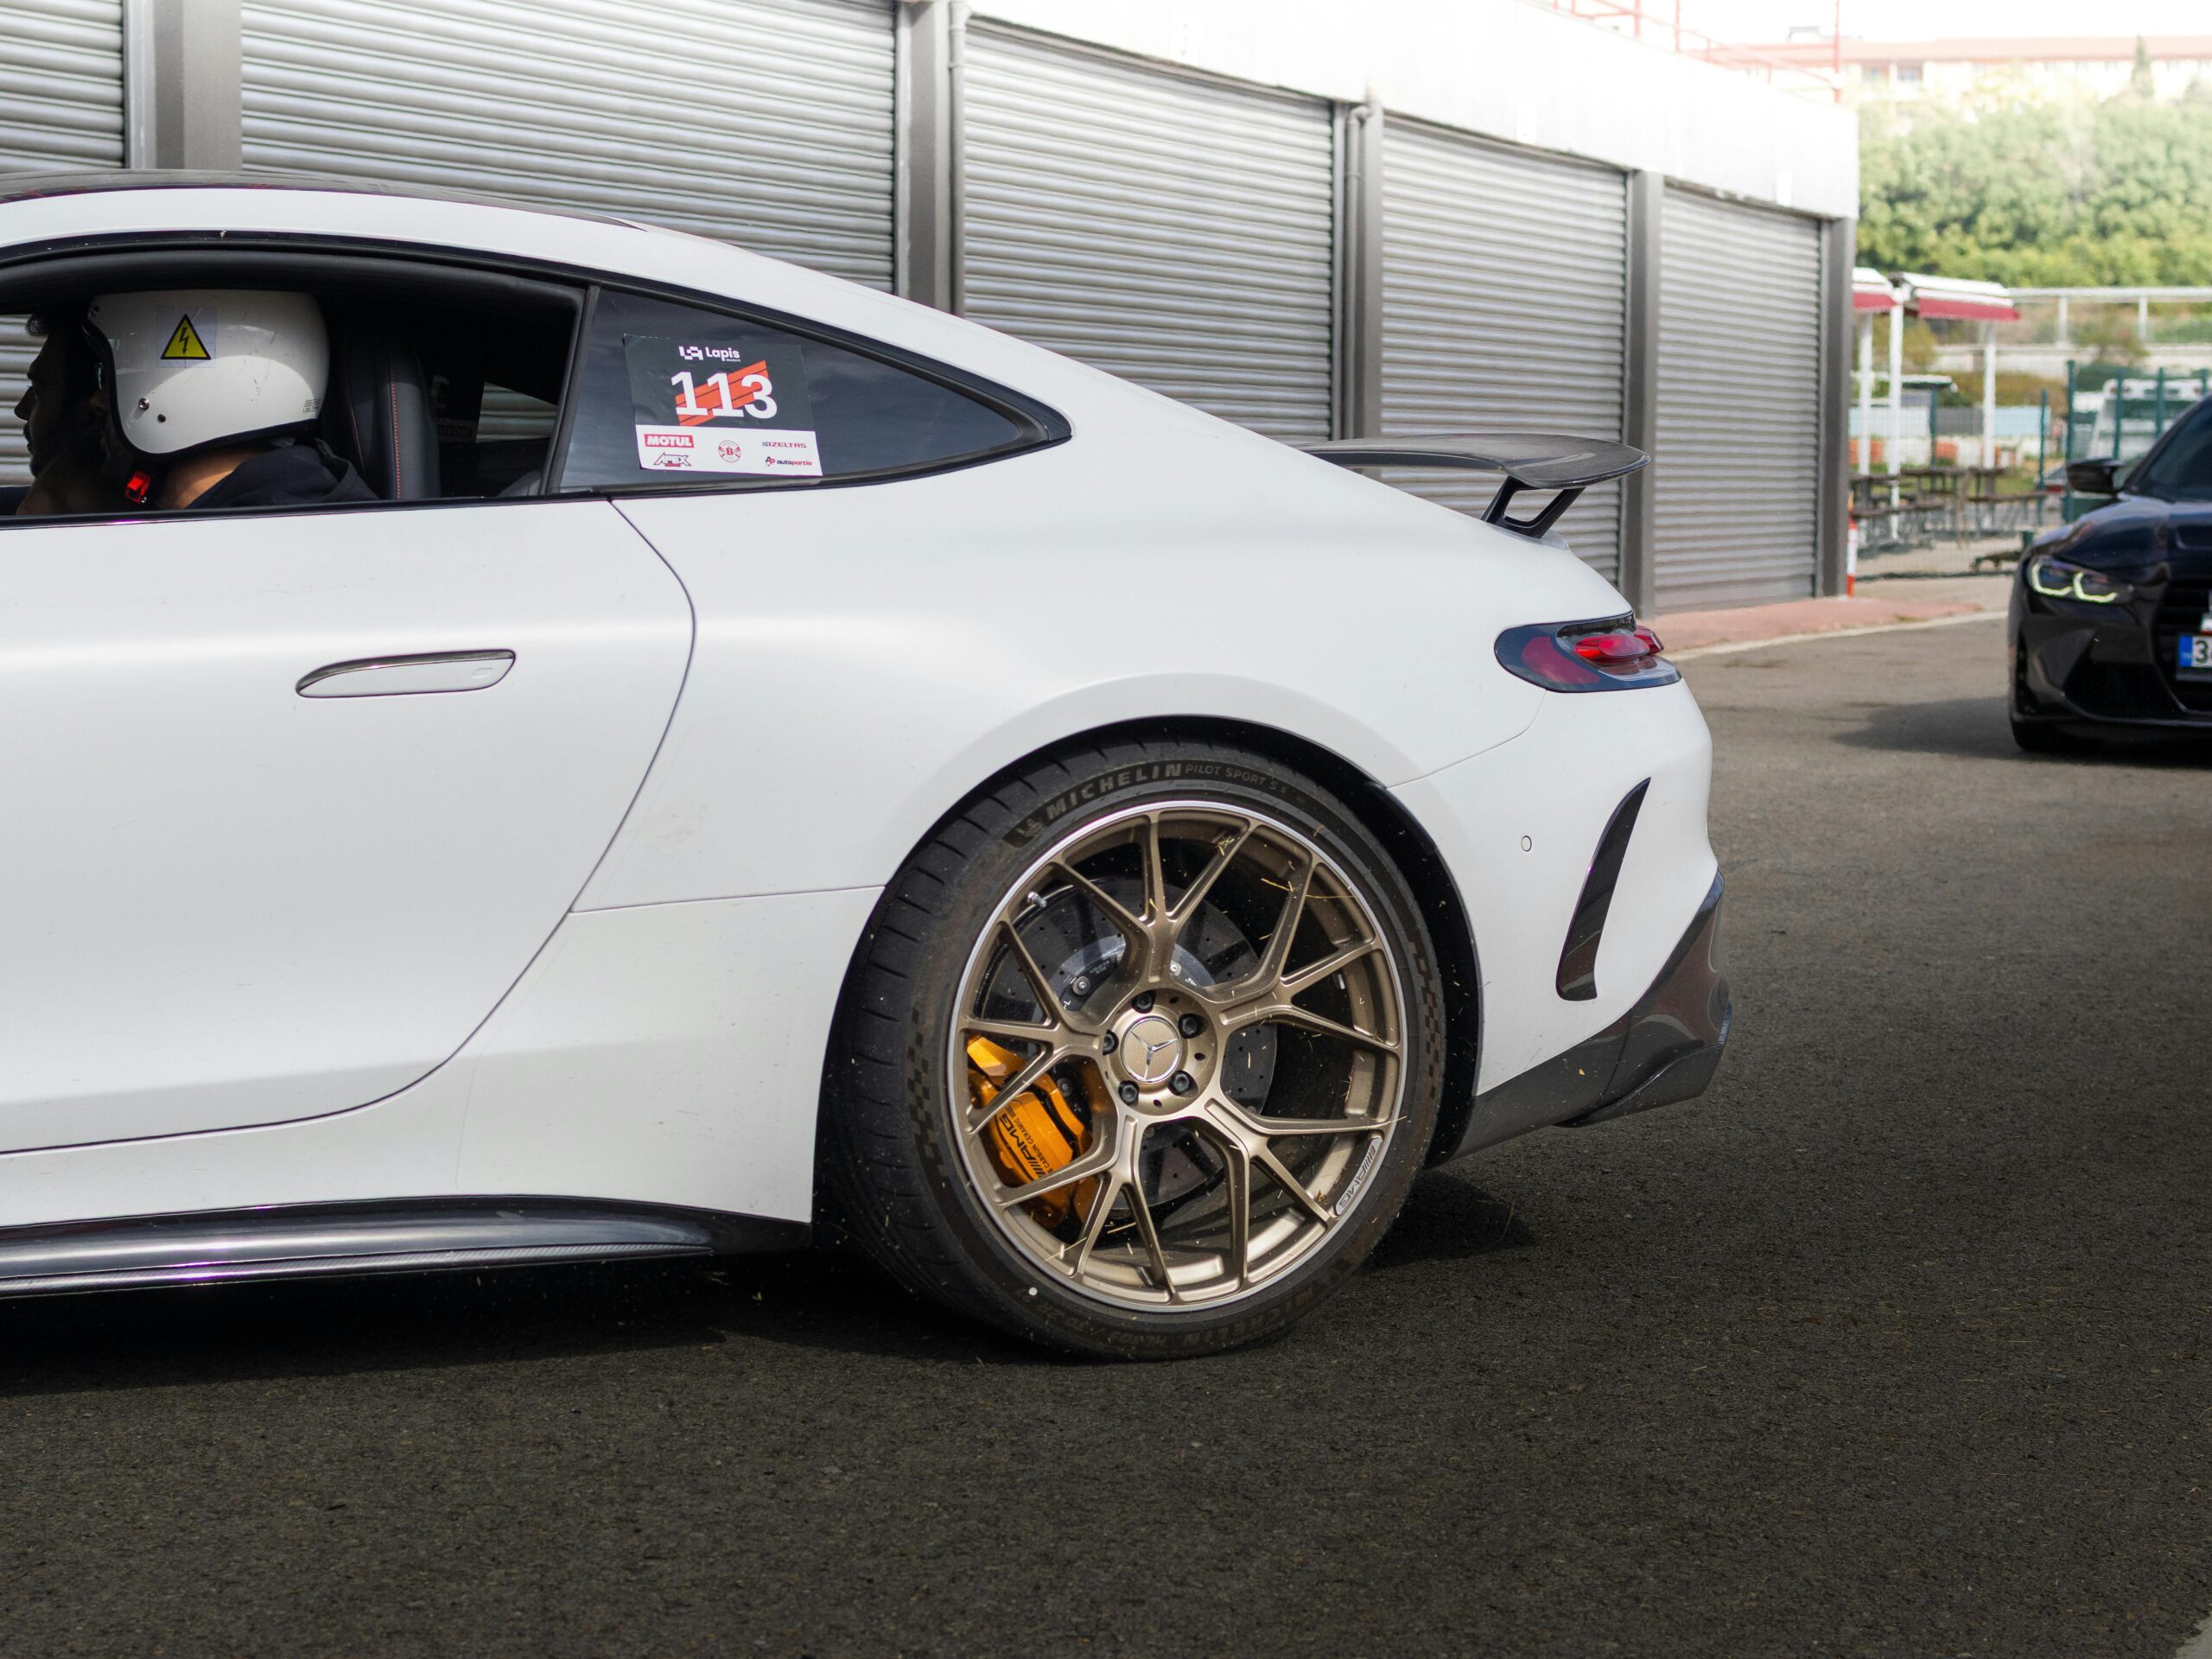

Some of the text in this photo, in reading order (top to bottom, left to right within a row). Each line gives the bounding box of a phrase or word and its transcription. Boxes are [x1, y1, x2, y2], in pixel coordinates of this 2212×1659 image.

[705, 346, 741, 361] Lapis
[671, 372, 778, 419] 113
[646, 435, 693, 447] MOTUL
[653, 453, 692, 466] APEX
[1046, 763, 1183, 820] MICHELIN
[1185, 764, 1221, 775] PILOT
[1226, 767, 1267, 785] SPORT
[1000, 1113, 1037, 1160] AMG
[1014, 1117, 1050, 1168] CARBON CERAMIC
